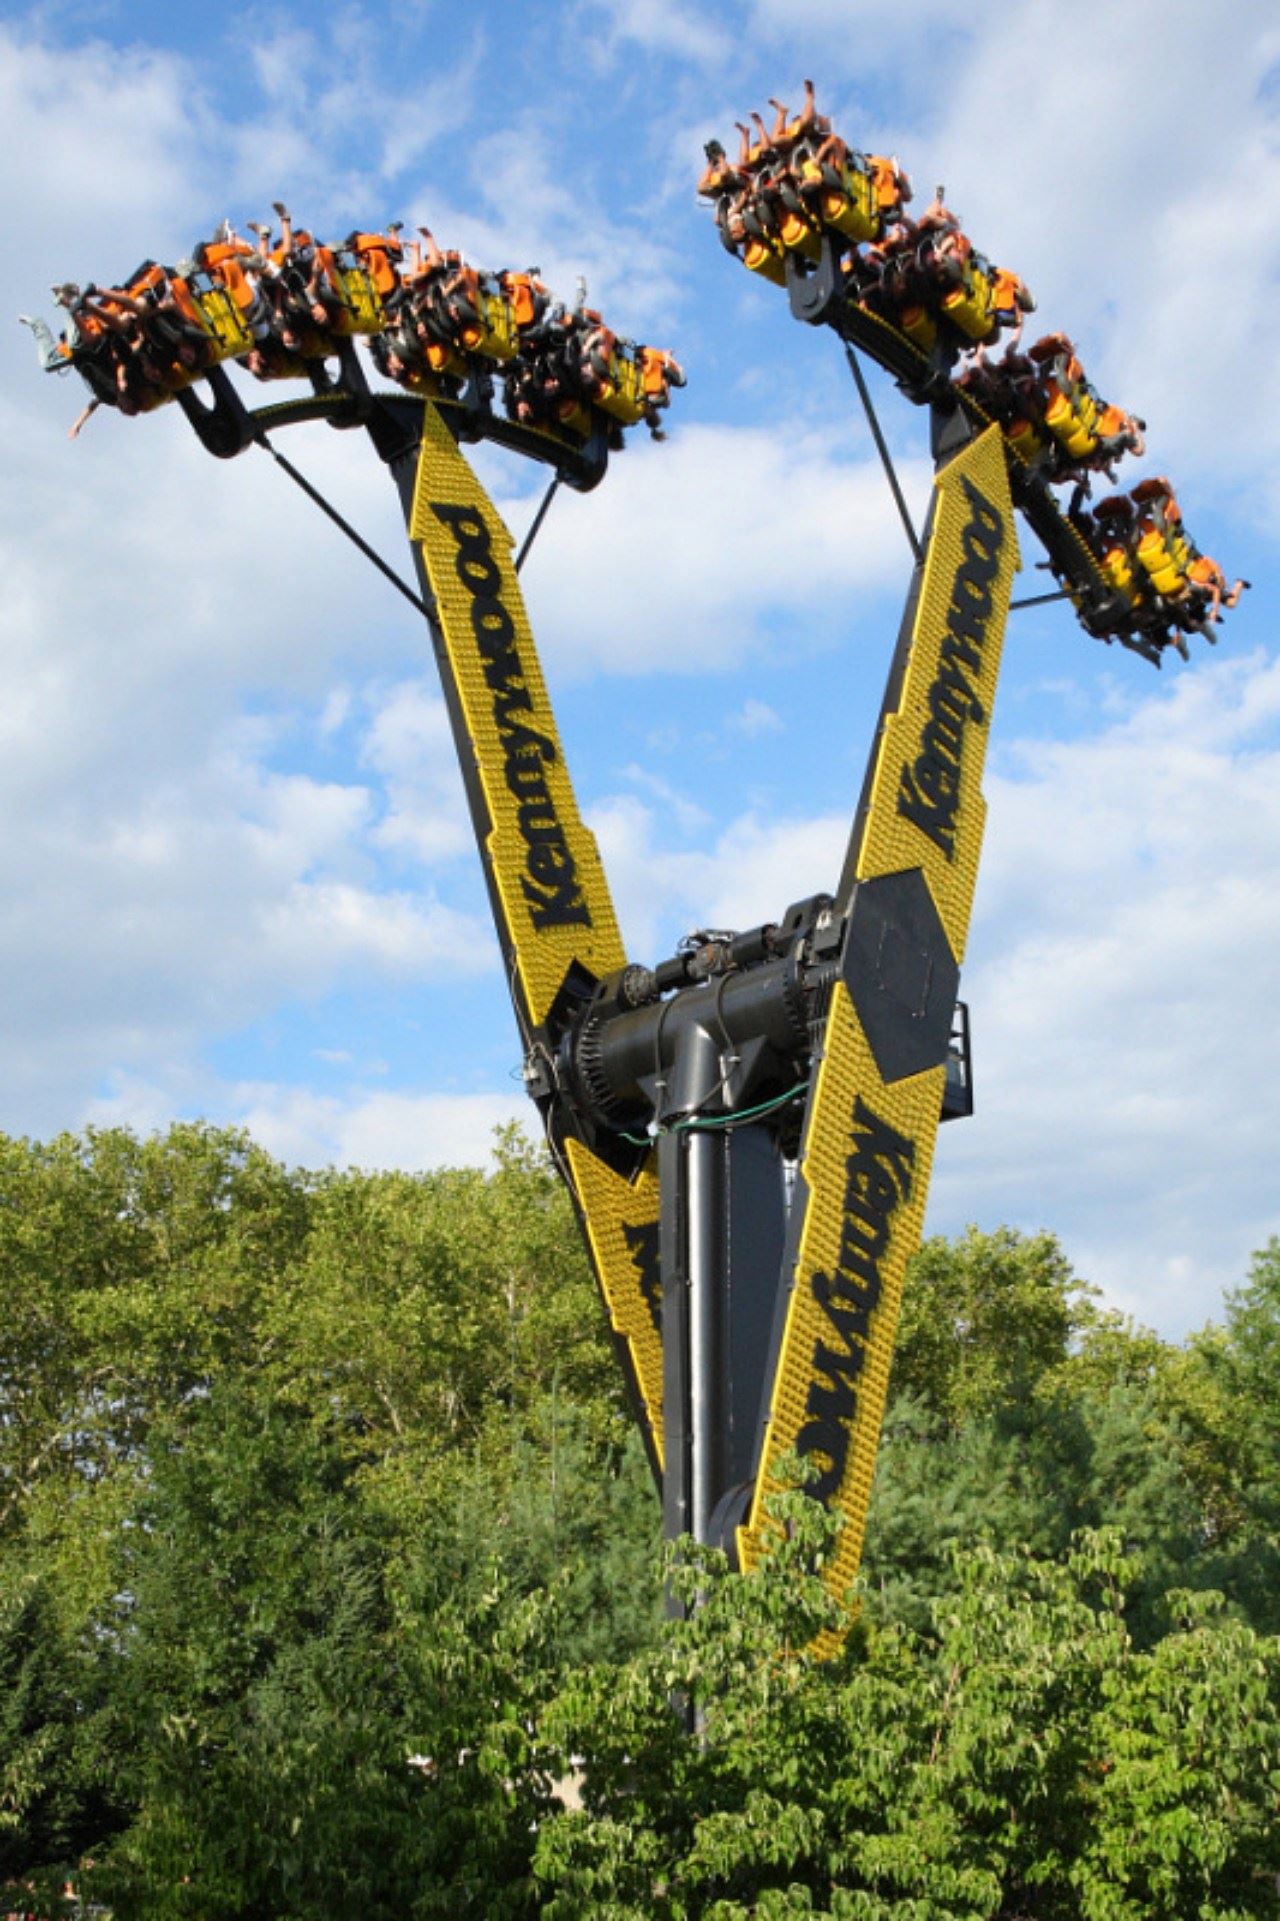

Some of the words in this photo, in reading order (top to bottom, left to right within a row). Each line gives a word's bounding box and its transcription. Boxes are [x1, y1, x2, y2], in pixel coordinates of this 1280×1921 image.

[430, 503, 592, 930] Kennywood
[898, 474, 1005, 863] Kennywood
[796, 1094, 915, 1514] Kennywo
